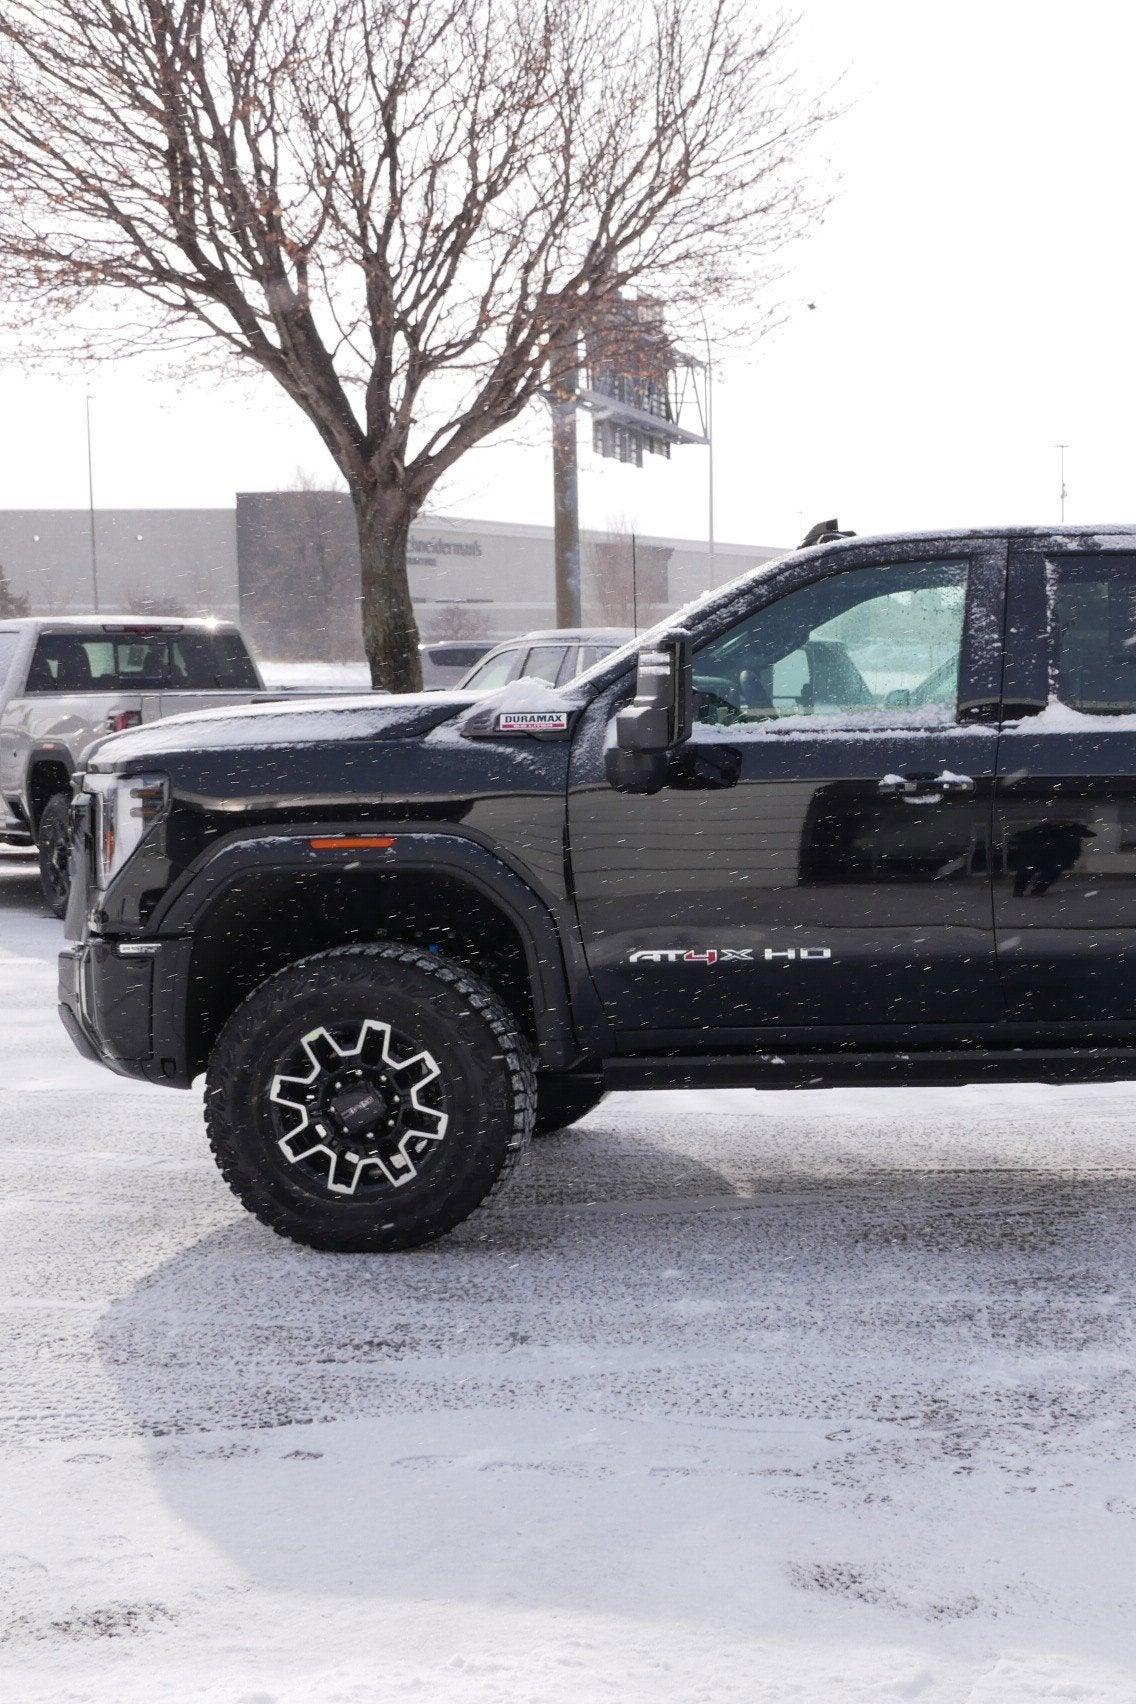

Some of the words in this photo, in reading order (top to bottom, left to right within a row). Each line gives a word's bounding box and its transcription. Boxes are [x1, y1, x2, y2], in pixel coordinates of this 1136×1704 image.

[505, 714, 563, 723] DURAMAX
[629, 949, 755, 966] AT4X
[763, 948, 832, 961] HD
